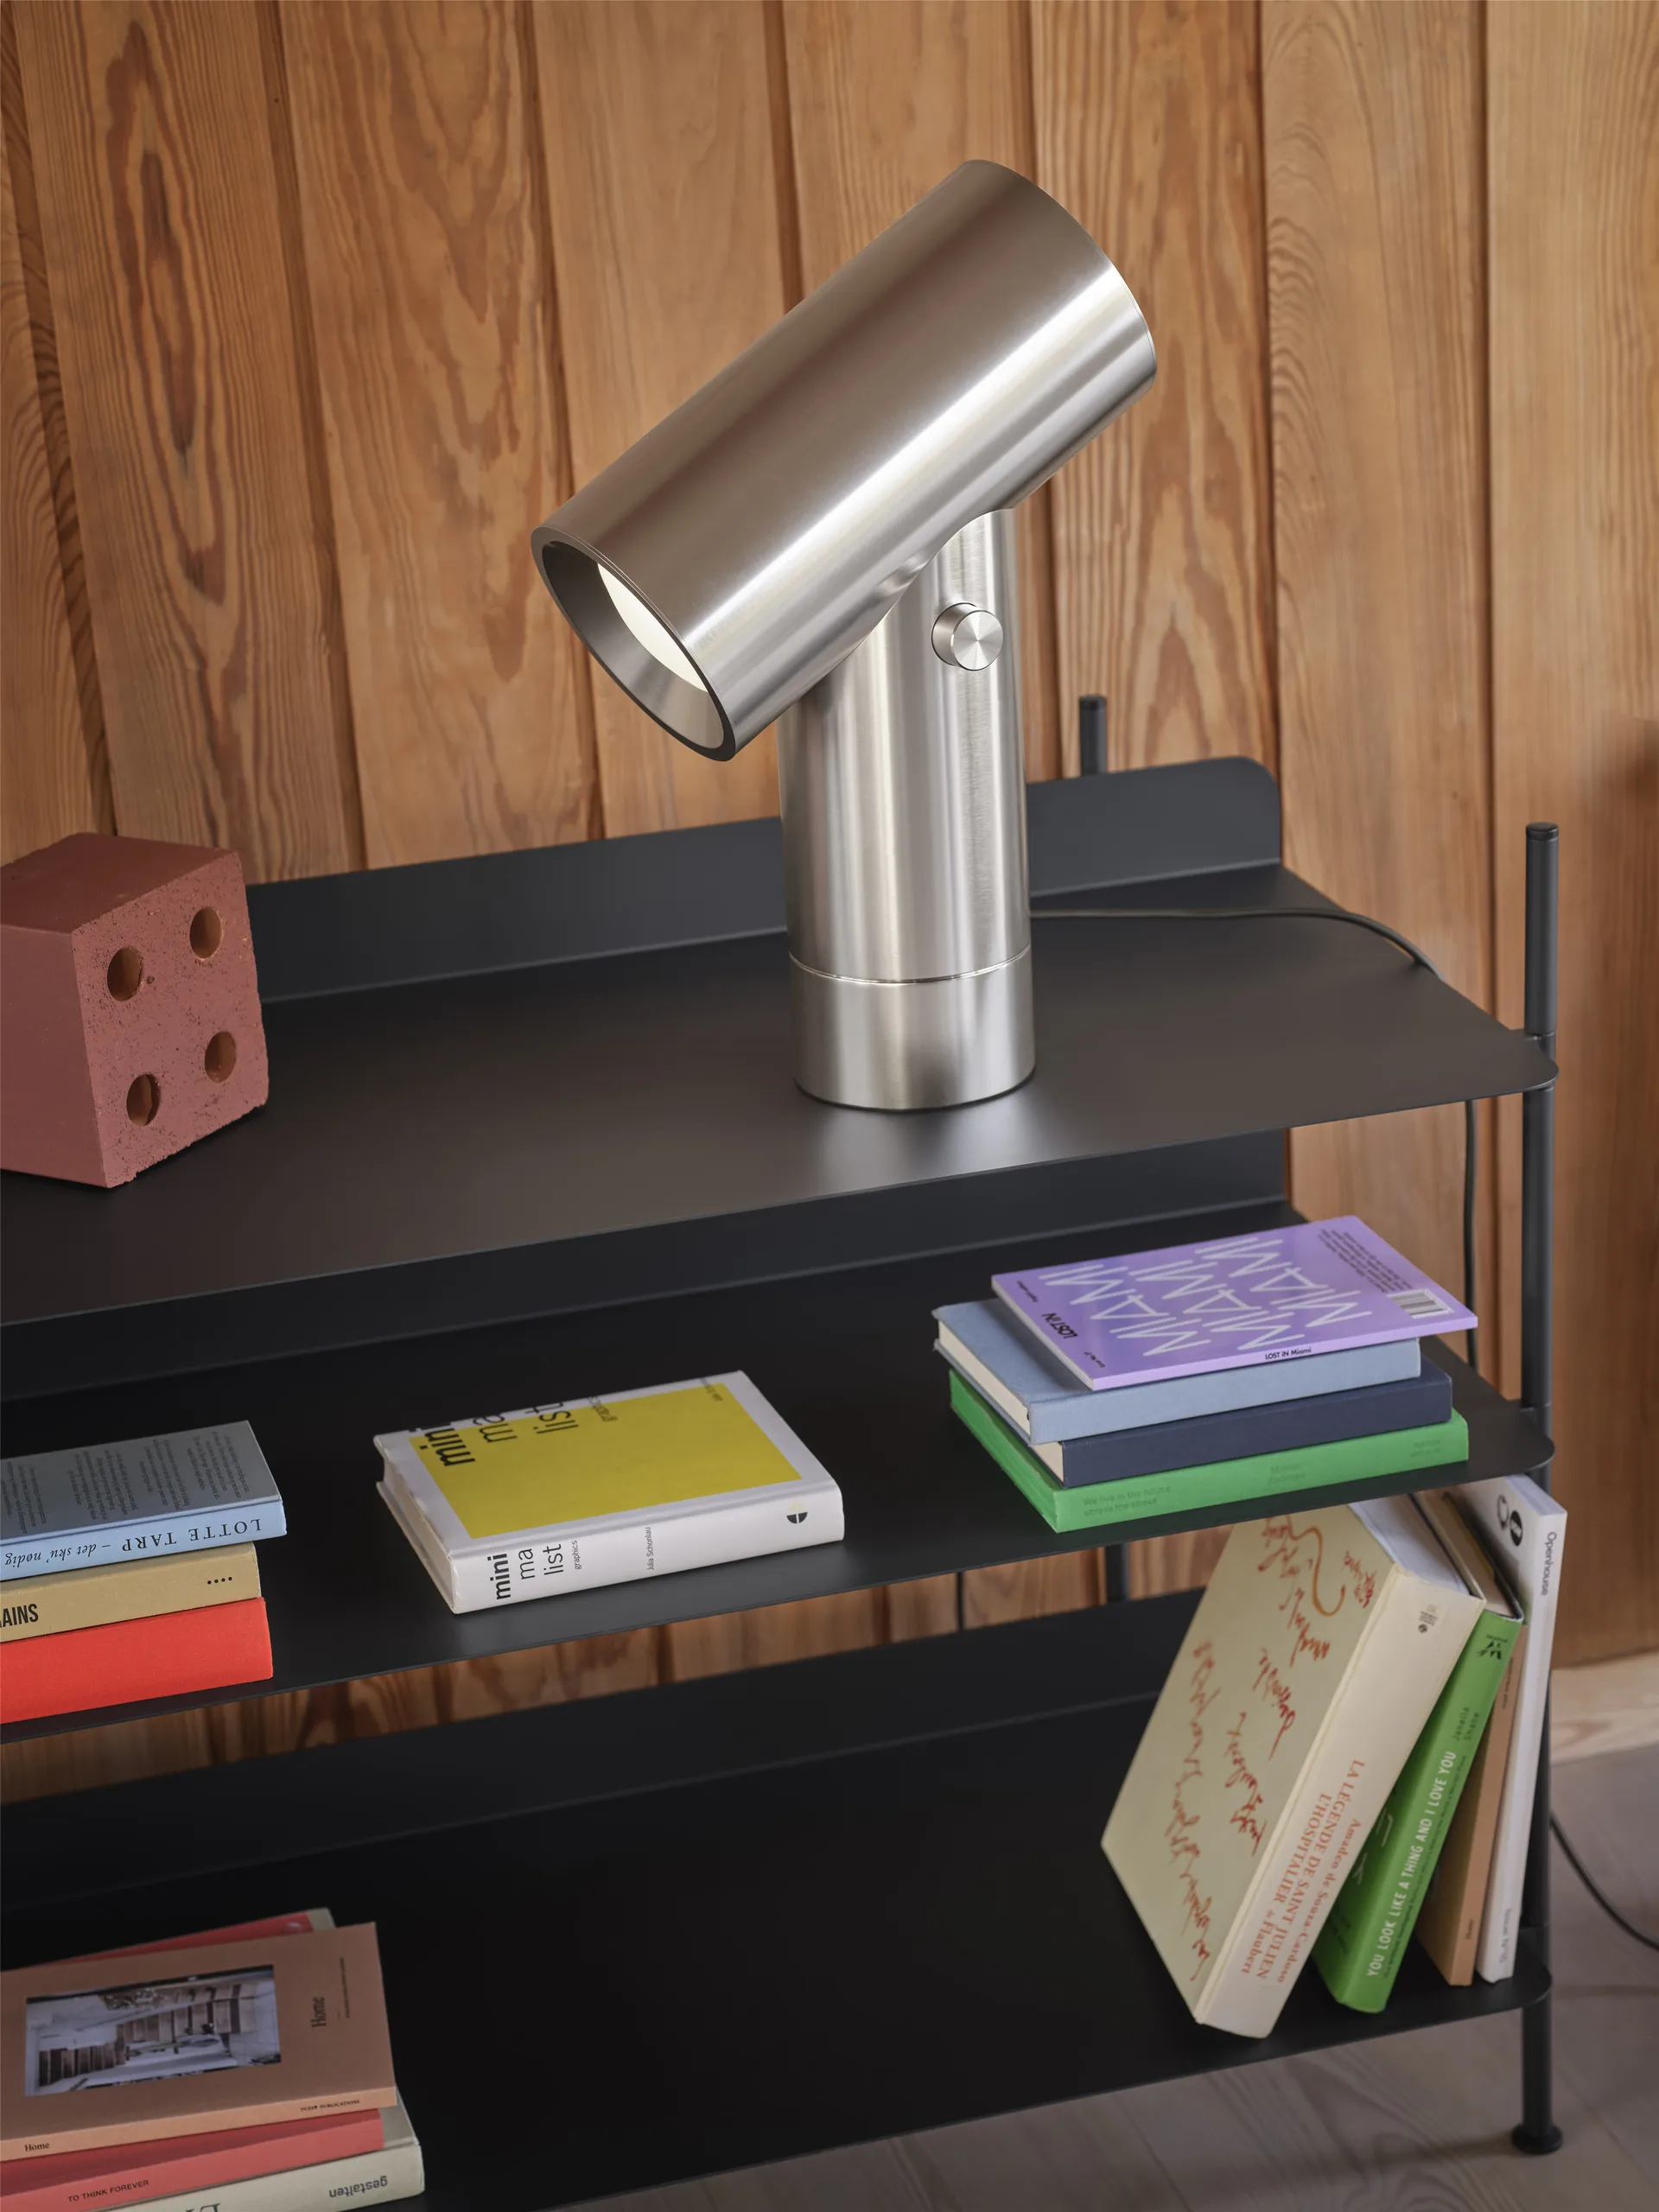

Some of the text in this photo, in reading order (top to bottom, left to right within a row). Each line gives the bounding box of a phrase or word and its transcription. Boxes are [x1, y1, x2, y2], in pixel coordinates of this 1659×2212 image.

[1265, 1351, 1281, 1360] LOST
[1291, 1346, 1313, 1357] Miami
[121, 1531, 177, 1553] TARP
[188, 1518, 262, 1541] LOTTE
[4, 1552, 42, 1568] nødig
[76, 1543, 97, 1557] det
[542, 1543, 564, 1576] list
[571, 1540, 582, 1570] graphics
[486, 1553, 512, 1600] mini
[518, 1548, 536, 1580] ma
[1541, 1531, 1558, 1597] Openhouse
[0, 1603, 39, 1628] AINS
[1436, 1750, 1458, 1776] YOU
[1426, 1777, 1447, 1807] LOVE
[1413, 1816, 1434, 1843] AND
[1330, 1818, 1363, 1870] Amadeo
[1254, 1759, 1365, 1980] LA LÉGENDE DE SAINT JULIEN
[1400, 1842, 1424, 1878] THING
[1321, 1871, 1338, 1888] de
[1395, 1879, 1411, 1890] A
[1385, 1891, 1407, 1917] LIKE
[1239, 1919, 1275, 1976] Flaubert
[1375, 1919, 1398, 1951] LOOK
[1366, 1953, 1385, 1977] YOU
[310, 1995, 327, 2029] Home
[24, 2142, 50, 2152] Home
[82, 2188, 108, 2200] THINK
[109, 2179, 149, 2194] FOREVER
[328, 2175, 388, 2199] gestalten
